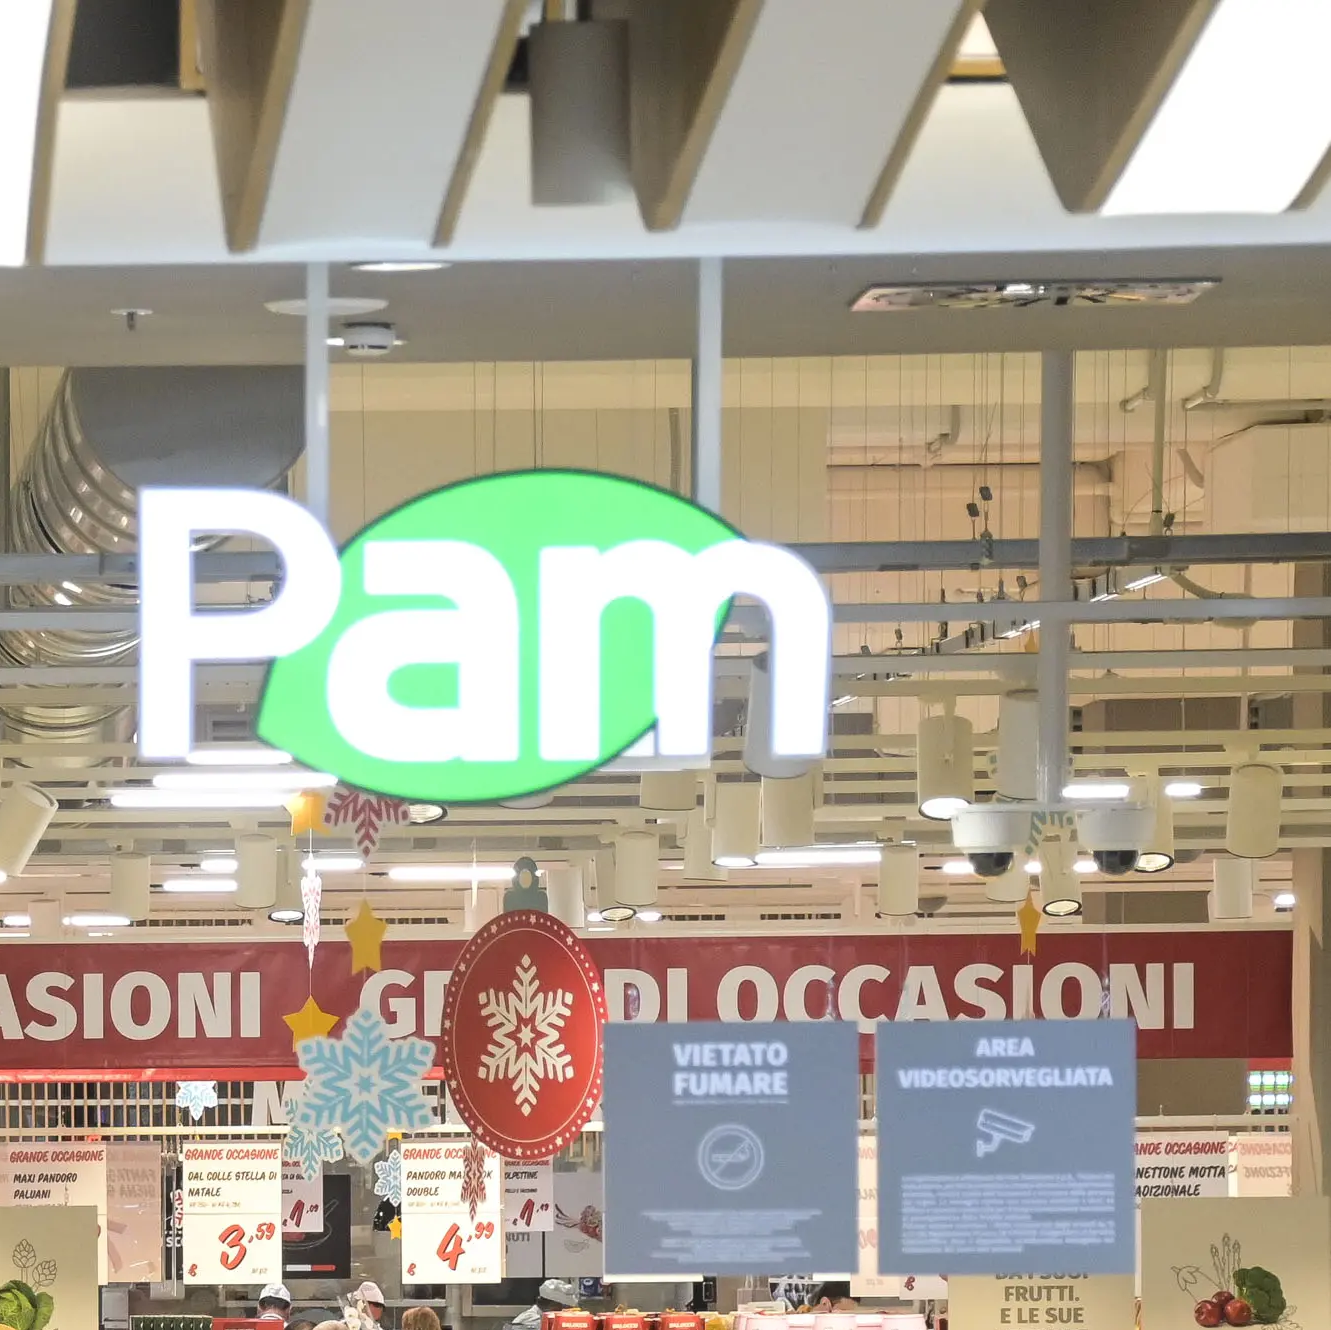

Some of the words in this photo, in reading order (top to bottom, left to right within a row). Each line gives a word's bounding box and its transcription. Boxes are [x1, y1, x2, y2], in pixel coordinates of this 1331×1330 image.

[137, 486, 831, 763] Pam
[359, 968, 689, 1038] GDI
[714, 962, 1195, 1032] OCCASIONI
[673, 1041, 788, 1067] VIETATO
[976, 1037, 1035, 1057] AREA
[673, 1070, 788, 1096] FUMARE
[898, 1067, 1113, 1088] VIDEOSORVEGLIATA
[185, 1149, 224, 1160] GRANDE
[226, 1148, 279, 1160] OCCASIONE
[403, 1148, 442, 1160] GRANDE
[444, 1148, 498, 1159] OCCNE
[1134, 1142, 1162, 1155] ANDE
[1164, 1141, 1227, 1155] OCCASIONE
[10, 1150, 49, 1163] GRANDE
[51, 1150, 104, 1162] OCCASIONE
[13, 1174, 36, 1183] MAXI
[37, 1172, 78, 1183] PANDORO
[188, 1171, 204, 1181] DAL
[206, 1171, 232, 1181] COLLE
[235, 1171, 266, 1181] STELLA
[268, 1171, 277, 1180] DI
[406, 1170, 447, 1180] PANDORO
[1136, 1165, 1186, 1178] NETTONE
[1188, 1165, 1226, 1178] MOTTA
[13, 1189, 51, 1200] PALUANI
[188, 1187, 221, 1197] NATALE
[406, 1186, 439, 1197] DOUBLE
[1135, 1184, 1201, 1198] ADIZIONALE
[218, 1222, 276, 1271] 3,59
[437, 1221, 495, 1271] 4,99
[1004, 1286, 1080, 1302] FRUTTI.
[1000, 1307, 1012, 1323] E
[1017, 1307, 1040, 1323] LE
[1045, 1307, 1085, 1323] SUE
